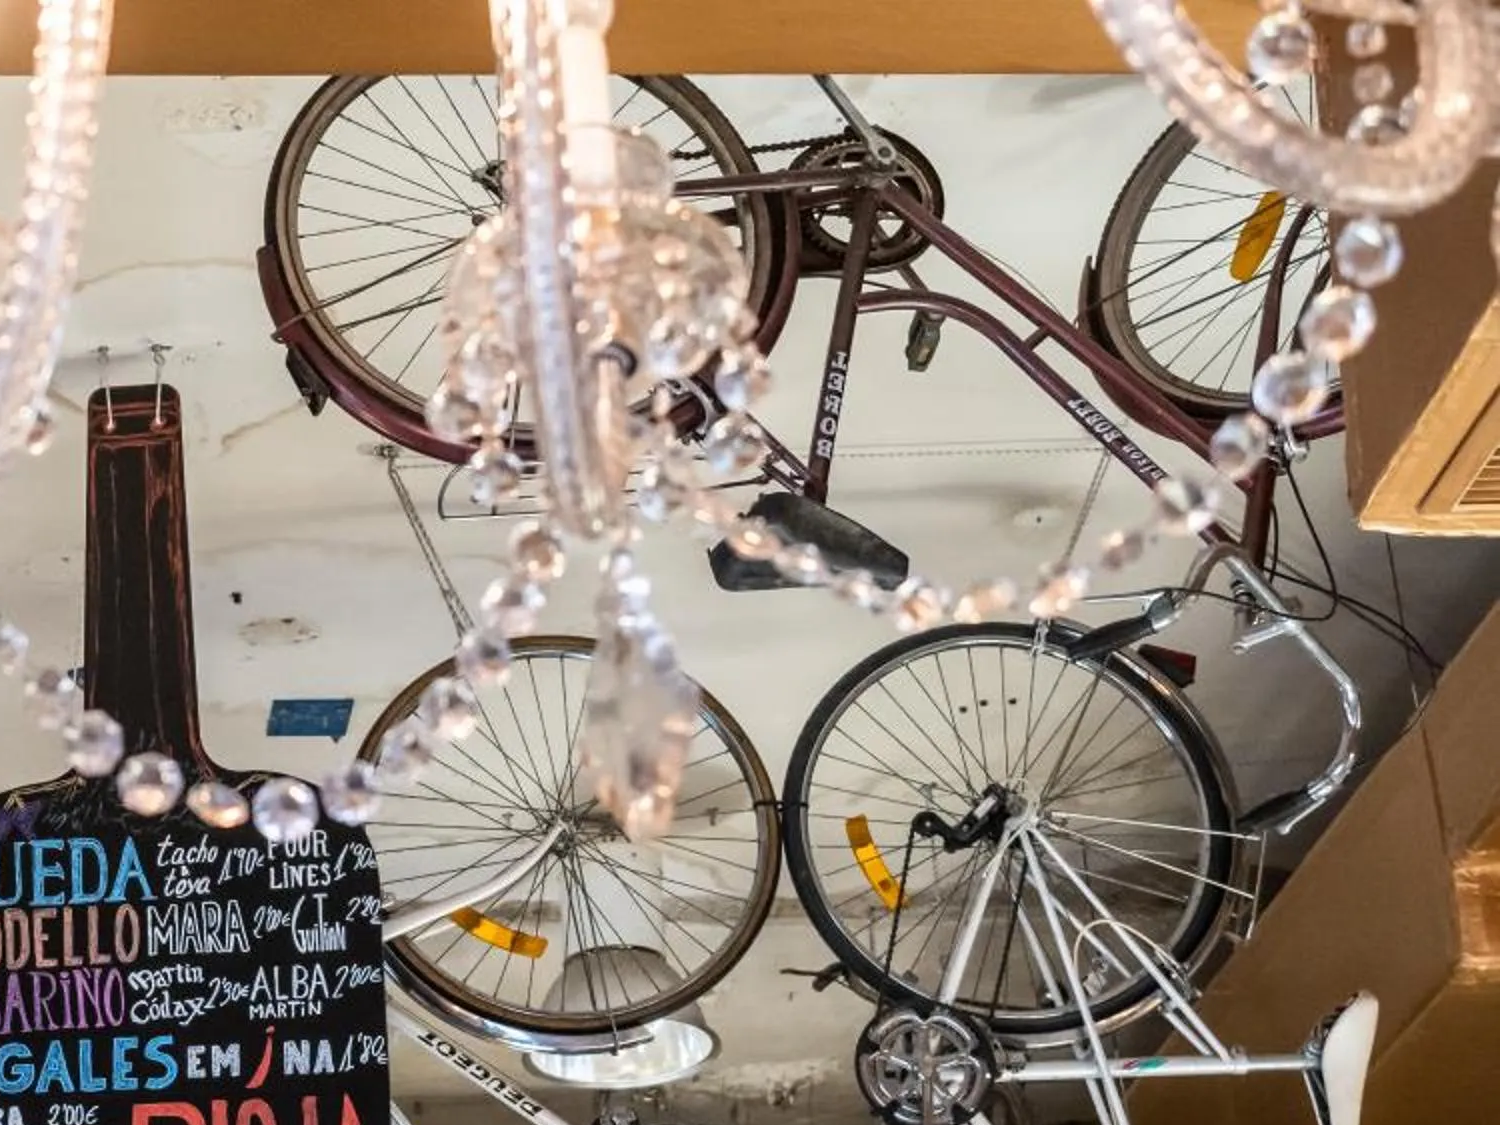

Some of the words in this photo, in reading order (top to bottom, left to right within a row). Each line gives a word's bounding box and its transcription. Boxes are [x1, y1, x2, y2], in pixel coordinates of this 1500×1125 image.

[157, 833, 219, 868] tacho
[147, 900, 251, 956] MARA
[251, 963, 330, 1001] ALBA
[417, 1031, 544, 1117] PEUGEOT
